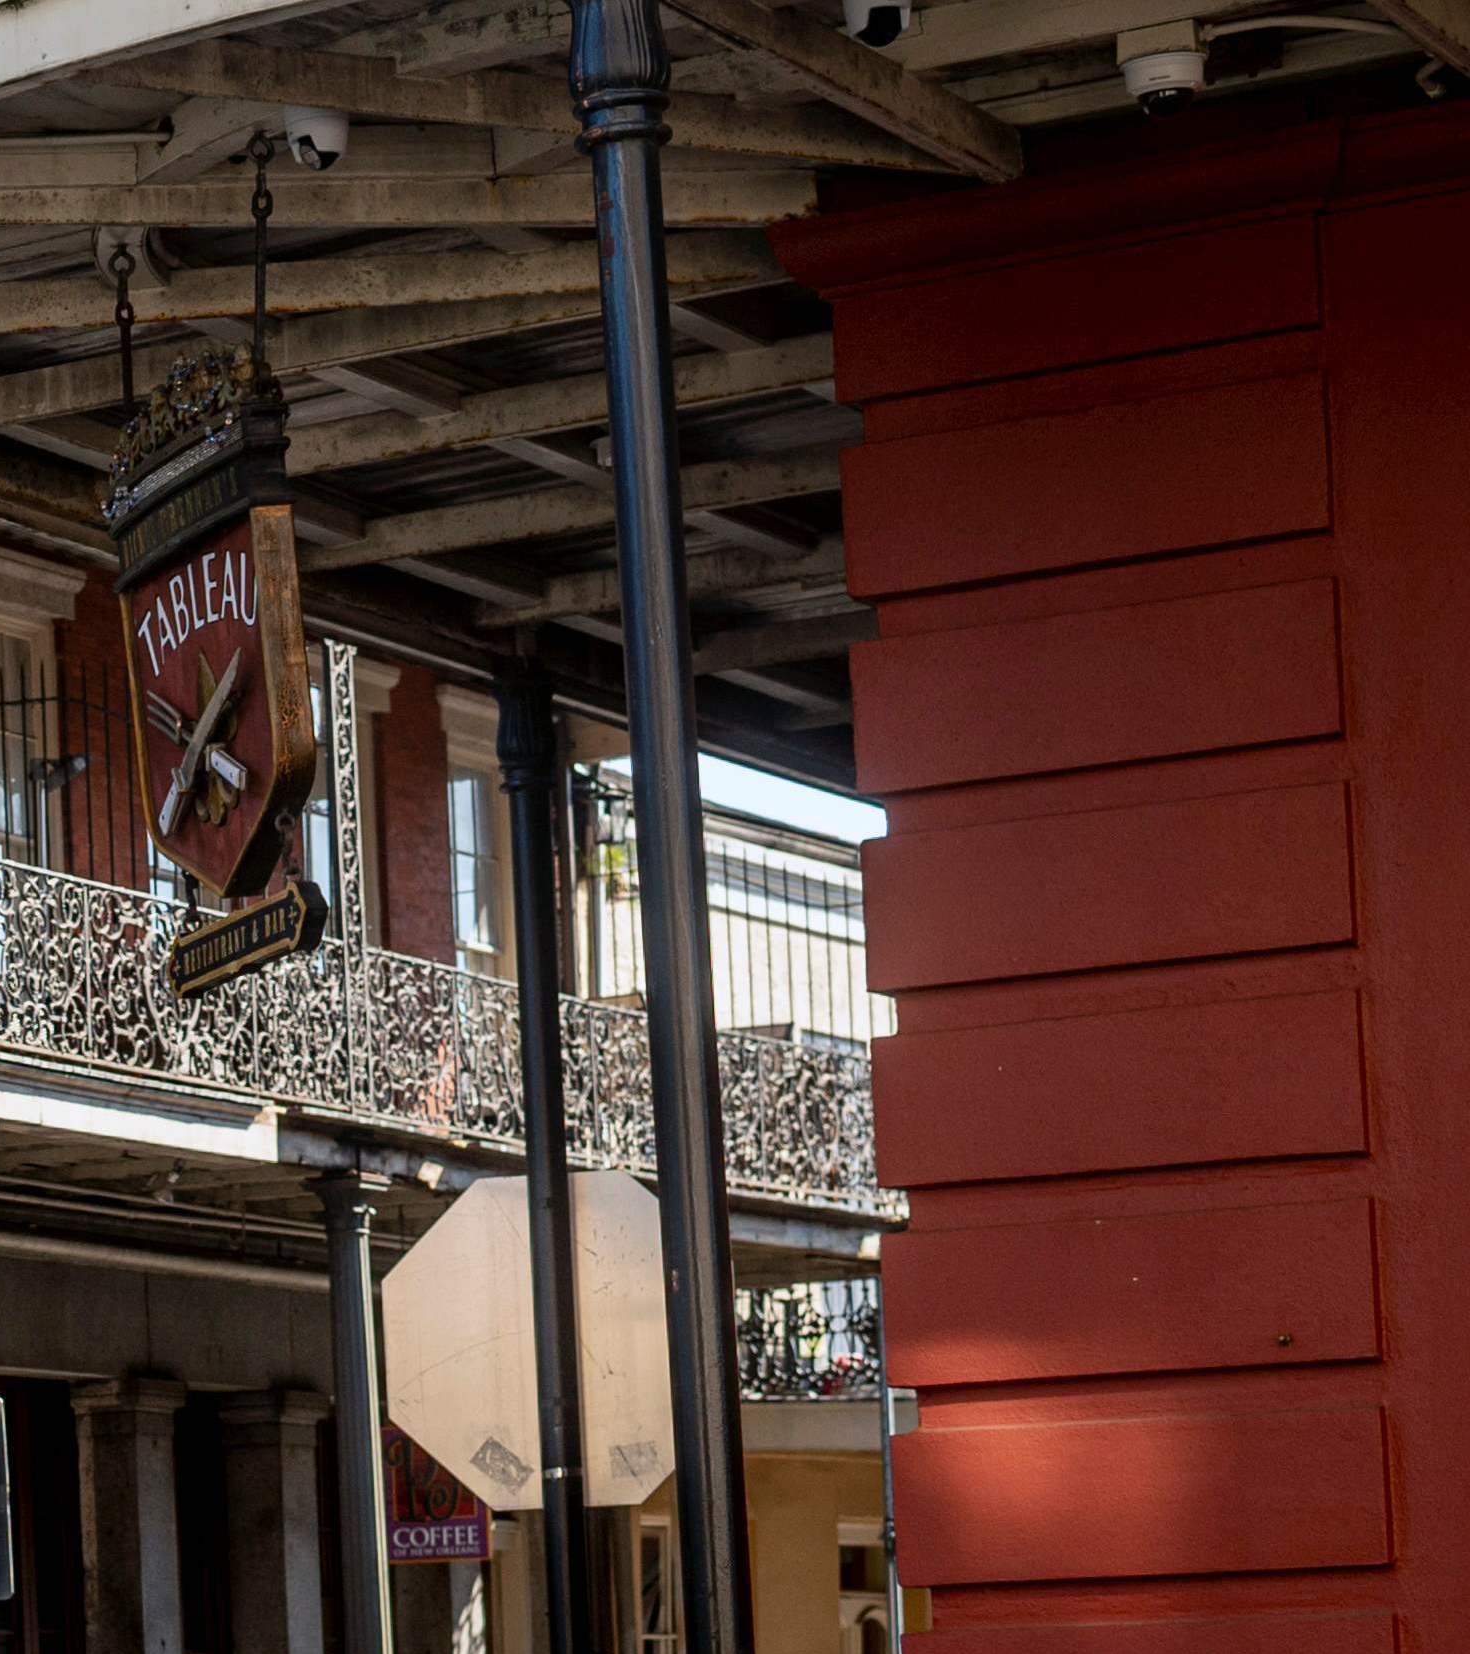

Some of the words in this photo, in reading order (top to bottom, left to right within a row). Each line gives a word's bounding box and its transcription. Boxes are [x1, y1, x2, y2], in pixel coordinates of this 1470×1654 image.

[138, 550, 258, 677] TABLEAU
[264, 907, 286, 939] BAR
[393, 1525, 478, 1548] COFFEE
